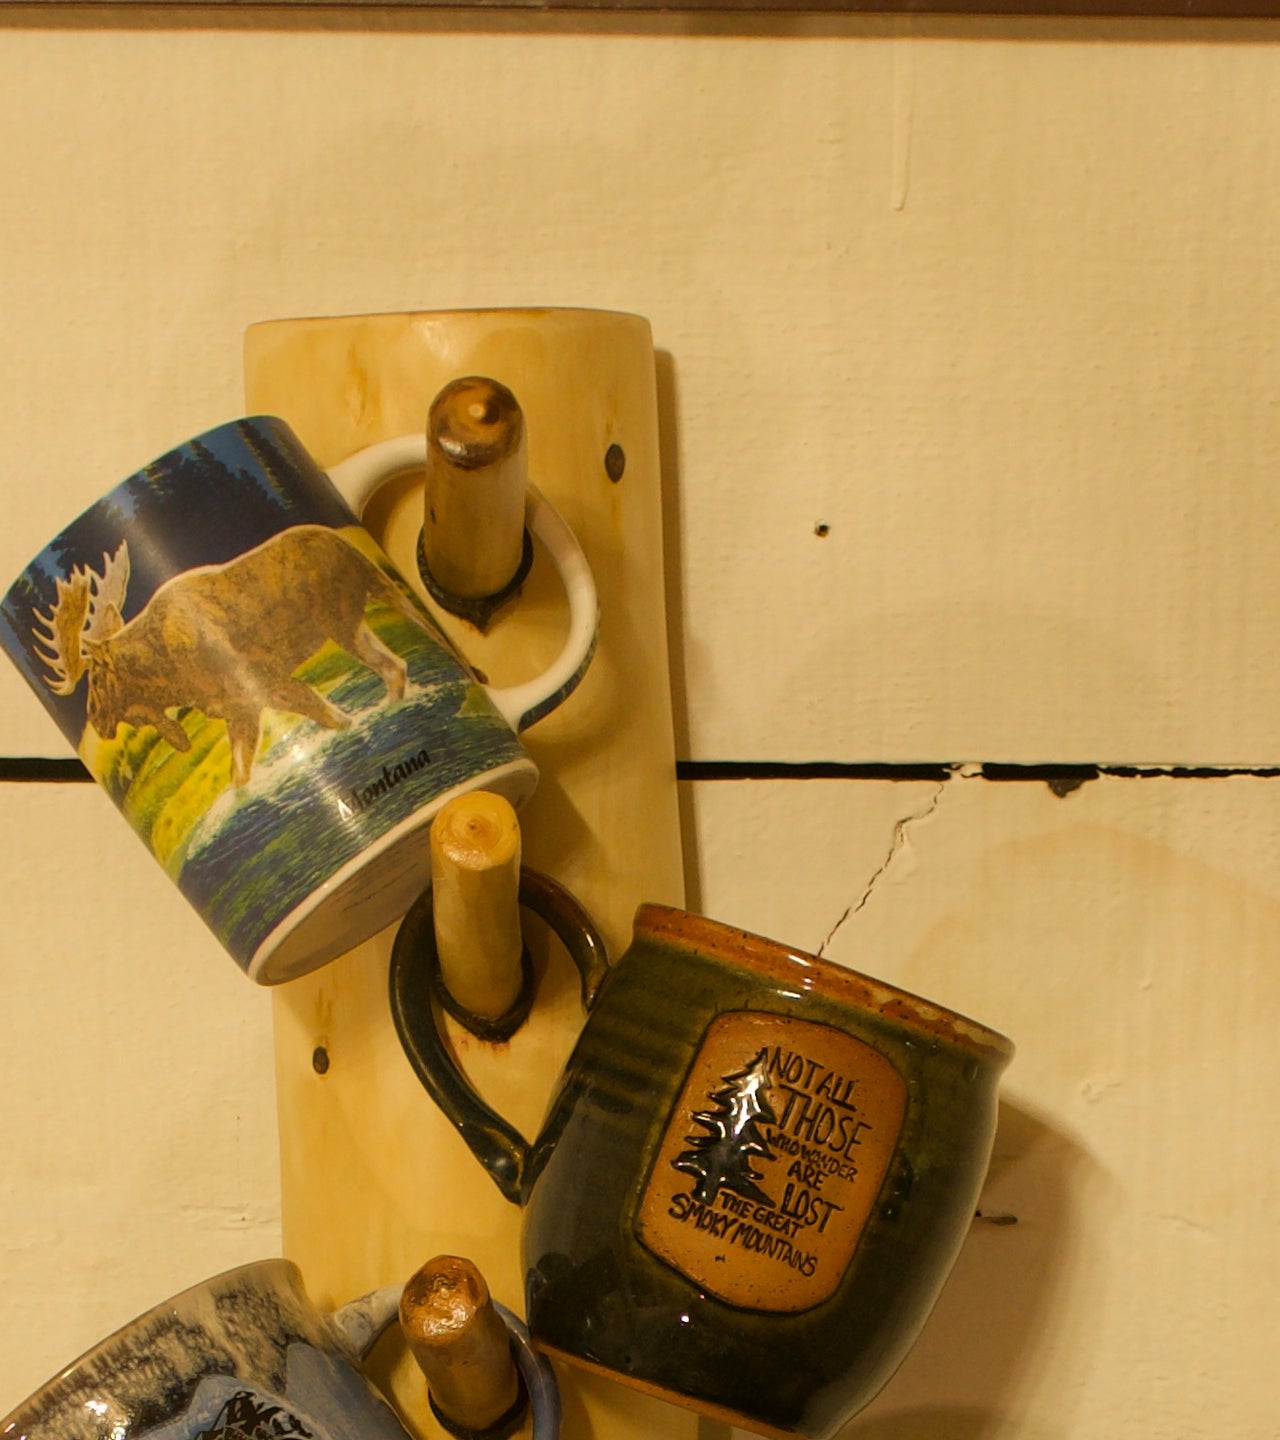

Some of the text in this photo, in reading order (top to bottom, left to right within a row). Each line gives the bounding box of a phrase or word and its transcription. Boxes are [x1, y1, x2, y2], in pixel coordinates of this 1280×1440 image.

[336, 750, 431, 822] Montana
[769, 1046, 857, 1111] NOT ALL
[778, 1083, 872, 1163] THOSE
[787, 1161, 830, 1190] ARE
[797, 1148, 858, 1184] WANDER
[668, 1192, 738, 1239] SMOKY
[720, 1191, 755, 1219] THE
[753, 1206, 806, 1239] GREAT
[780, 1182, 845, 1234] LOST
[730, 1222, 818, 1277] MOUNTAINS
